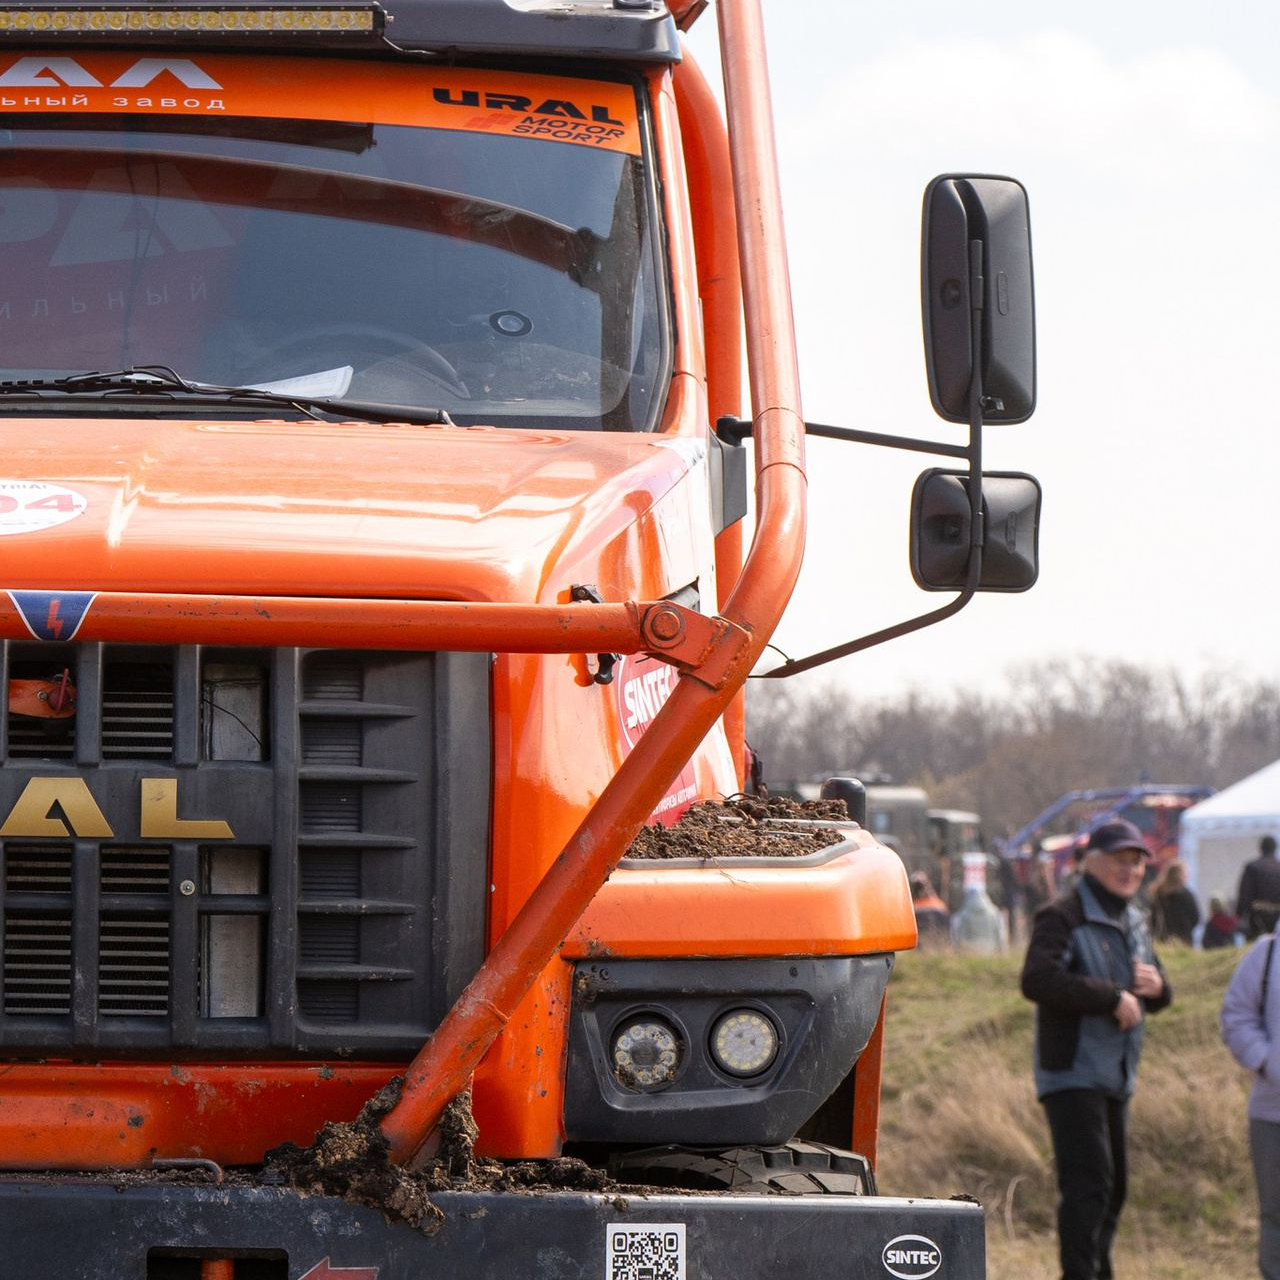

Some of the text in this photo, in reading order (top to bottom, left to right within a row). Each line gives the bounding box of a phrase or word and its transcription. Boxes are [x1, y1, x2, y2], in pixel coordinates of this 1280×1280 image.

[112, 96, 226, 110] завод
[432, 87, 625, 127] URAL
[512, 125, 612, 145] SPORT
[521, 116, 625, 139] MOTOR
[886, 1250, 937, 1265] SINTEC
